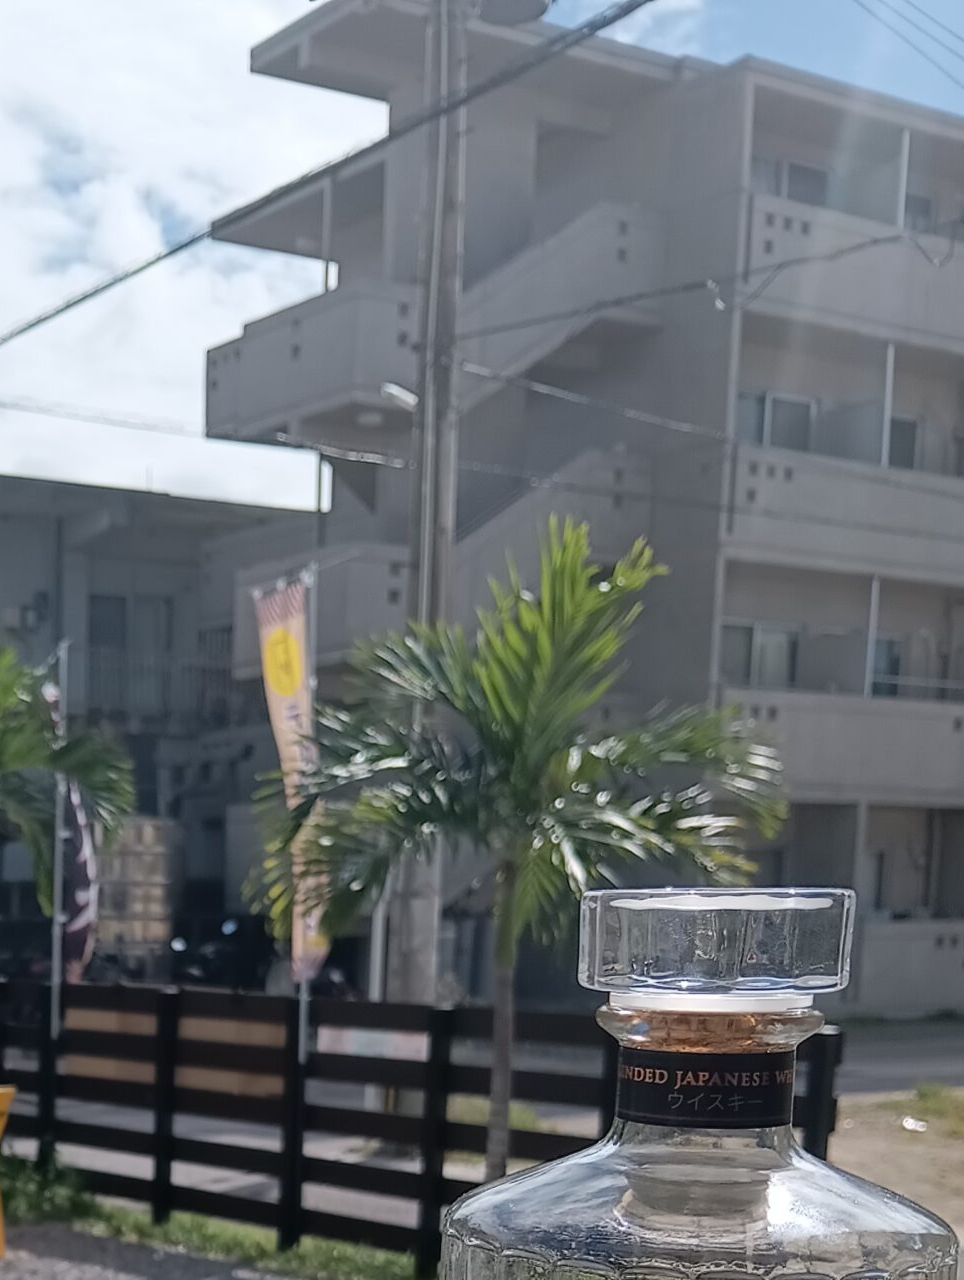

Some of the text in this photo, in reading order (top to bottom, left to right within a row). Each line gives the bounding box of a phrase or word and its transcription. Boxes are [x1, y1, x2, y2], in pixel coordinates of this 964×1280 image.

[674, 1070, 770, 1090] JAPANESE
[668, 1091, 763, 1111] ウイスキー
